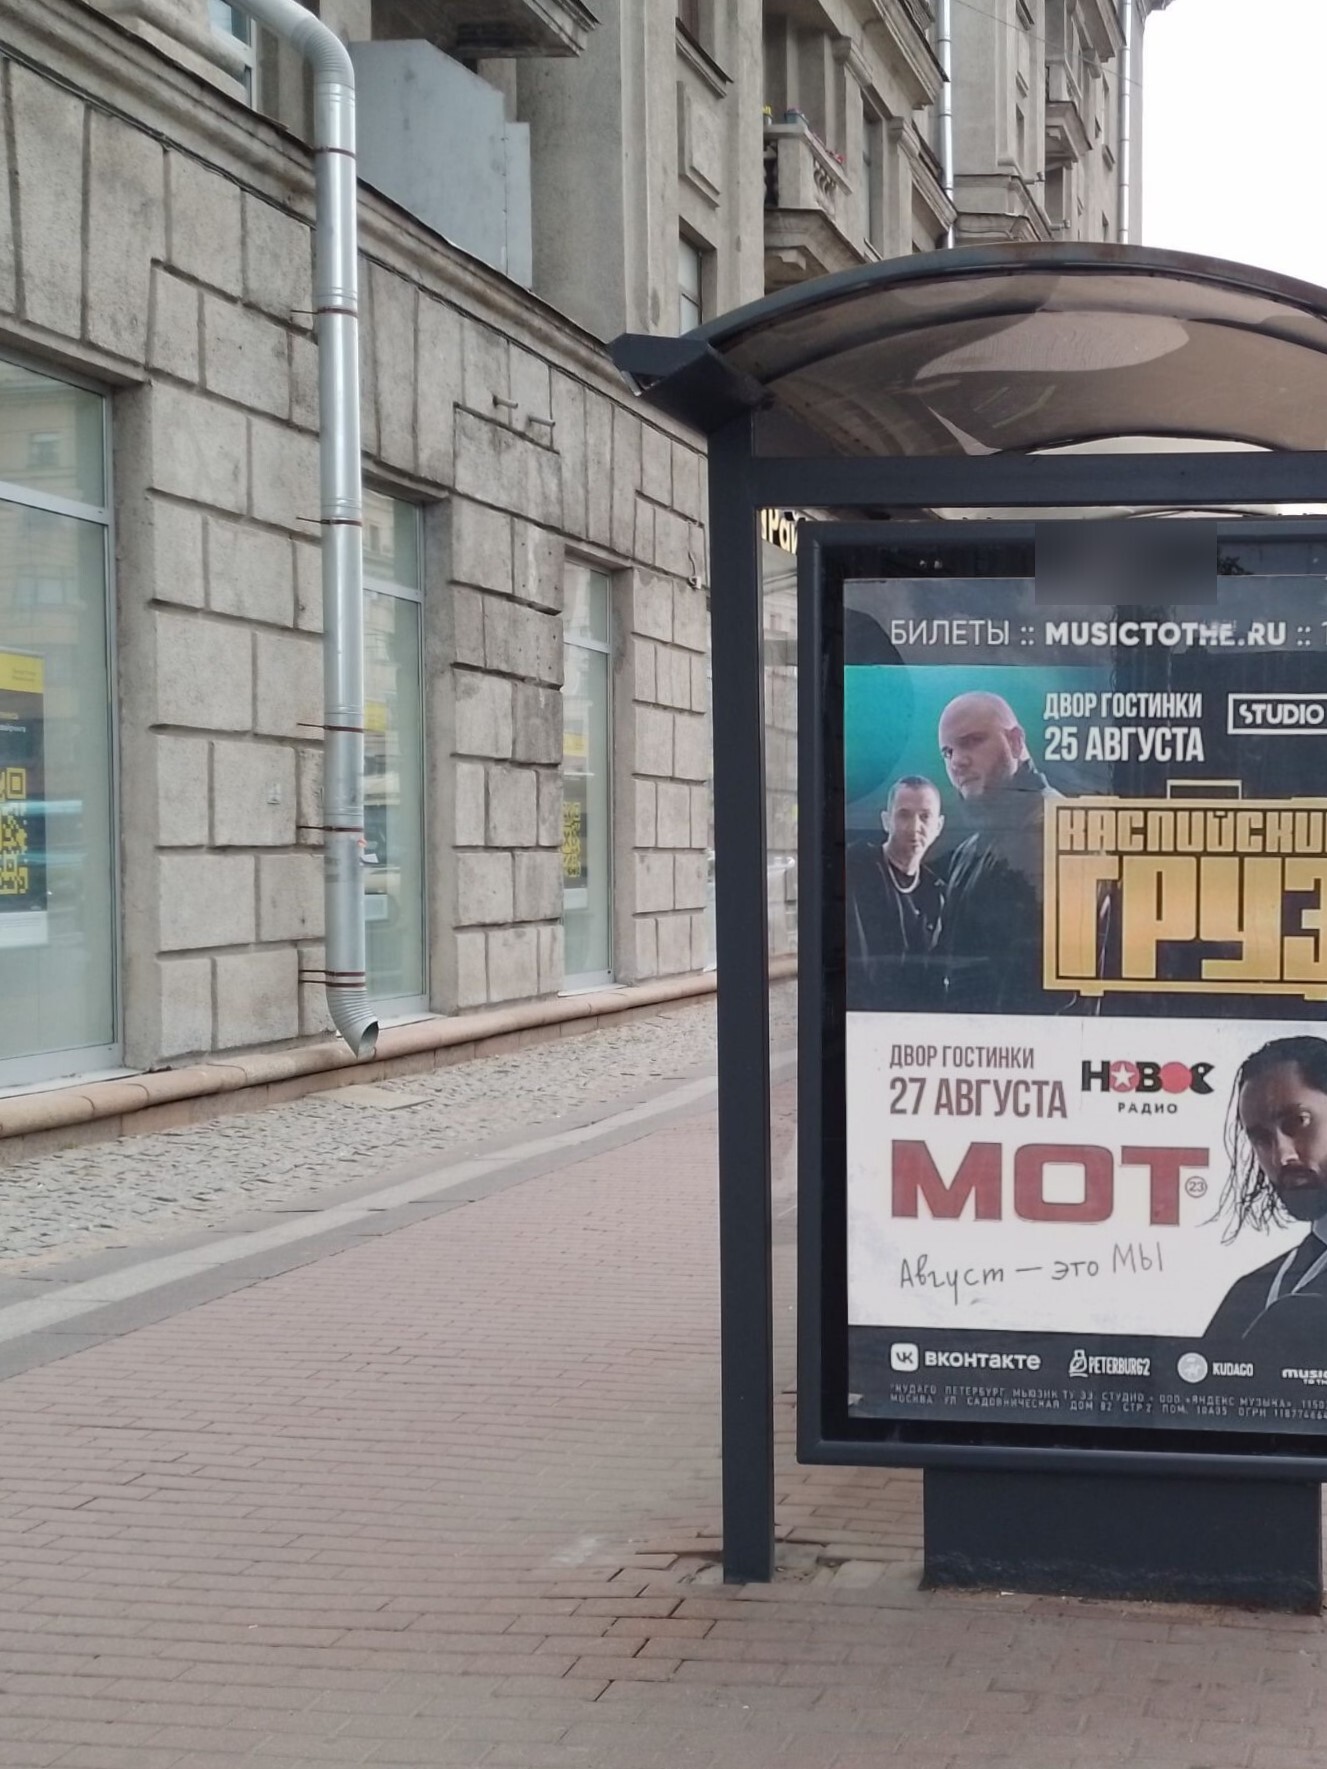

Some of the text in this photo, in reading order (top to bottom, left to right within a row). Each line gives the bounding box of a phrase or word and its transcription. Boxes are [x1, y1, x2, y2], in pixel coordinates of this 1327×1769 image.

[891, 620, 1009, 646] БИЛЕТЫ
[1045, 621, 1286, 646] MUSICTOTHE.RU
[1044, 692, 1202, 721] ДВОР ГОСТИНКИ
[1239, 703, 1325, 725] STUDIO
[1044, 727, 1204, 762] 25 АВГУСТА
[889, 1044, 1034, 1070] ДВОР ГОСТИНКИ
[1082, 1060, 1215, 1095] НОВОЕ
[889, 1077, 1067, 1118] 27 АВГУСТА
[1117, 1102, 1178, 1115] РАДИО
[891, 1140, 1210, 1226] МОТ
[1188, 1180, 1205, 1193] 23
[900, 1255, 1005, 1306] Август
[1052, 1259, 1099, 1281] это
[1112, 1242, 1163, 1274] МЫ
[1088, 1356, 1151, 1376] PETERBURG2
[1212, 1362, 1254, 1377] KUDAGO
